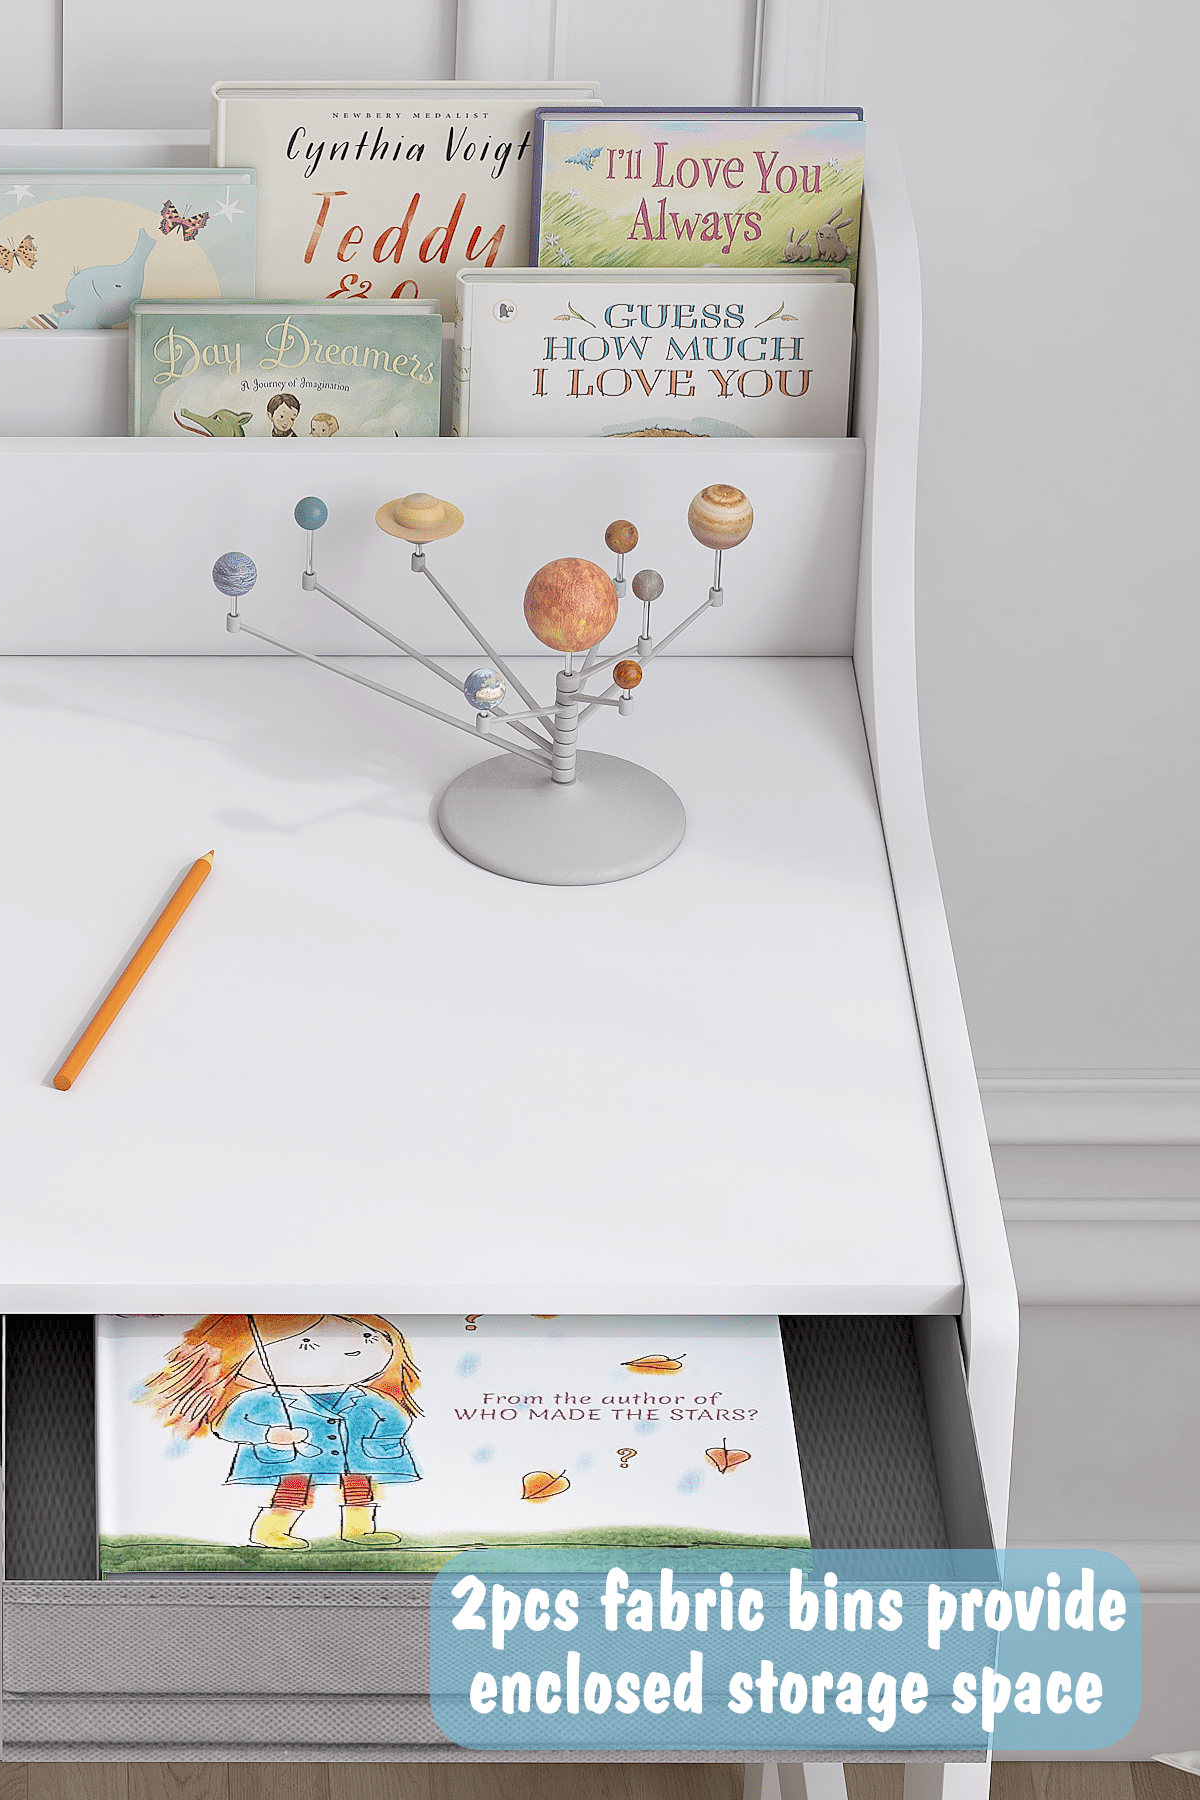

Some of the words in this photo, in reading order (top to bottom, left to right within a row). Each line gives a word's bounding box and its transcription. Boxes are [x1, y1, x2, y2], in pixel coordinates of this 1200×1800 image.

[286, 127, 426, 179] Cynthia
[445, 127, 532, 179] Voigt
[652, 142, 745, 189] Love
[753, 151, 823, 194] You
[303, 192, 506, 267] Teddy
[627, 197, 763, 254] Always
[604, 303, 746, 330] GUESS
[153, 326, 241, 385] Day
[259, 315, 435, 385] Dreamers
[543, 336, 652, 362] HOW
[666, 336, 805, 362] MUCH
[240, 380, 251, 392] A
[253, 378, 286, 392] Journey
[287, 378, 298, 388] of
[299, 376, 350, 392] Imagination
[532, 368, 549, 397] I
[567, 368, 696, 399] LOVE
[708, 369, 814, 399] YOU
[483, 1392, 544, 1406] From
[553, 1392, 592, 1405] the
[601, 1391, 685, 1406] author
[694, 1391, 723, 1406] of
[454, 1407, 518, 1421] WHO
[528, 1408, 601, 1421] MADE
[611, 1408, 660, 1421] THE
[669, 1408, 759, 1422] STARS?
